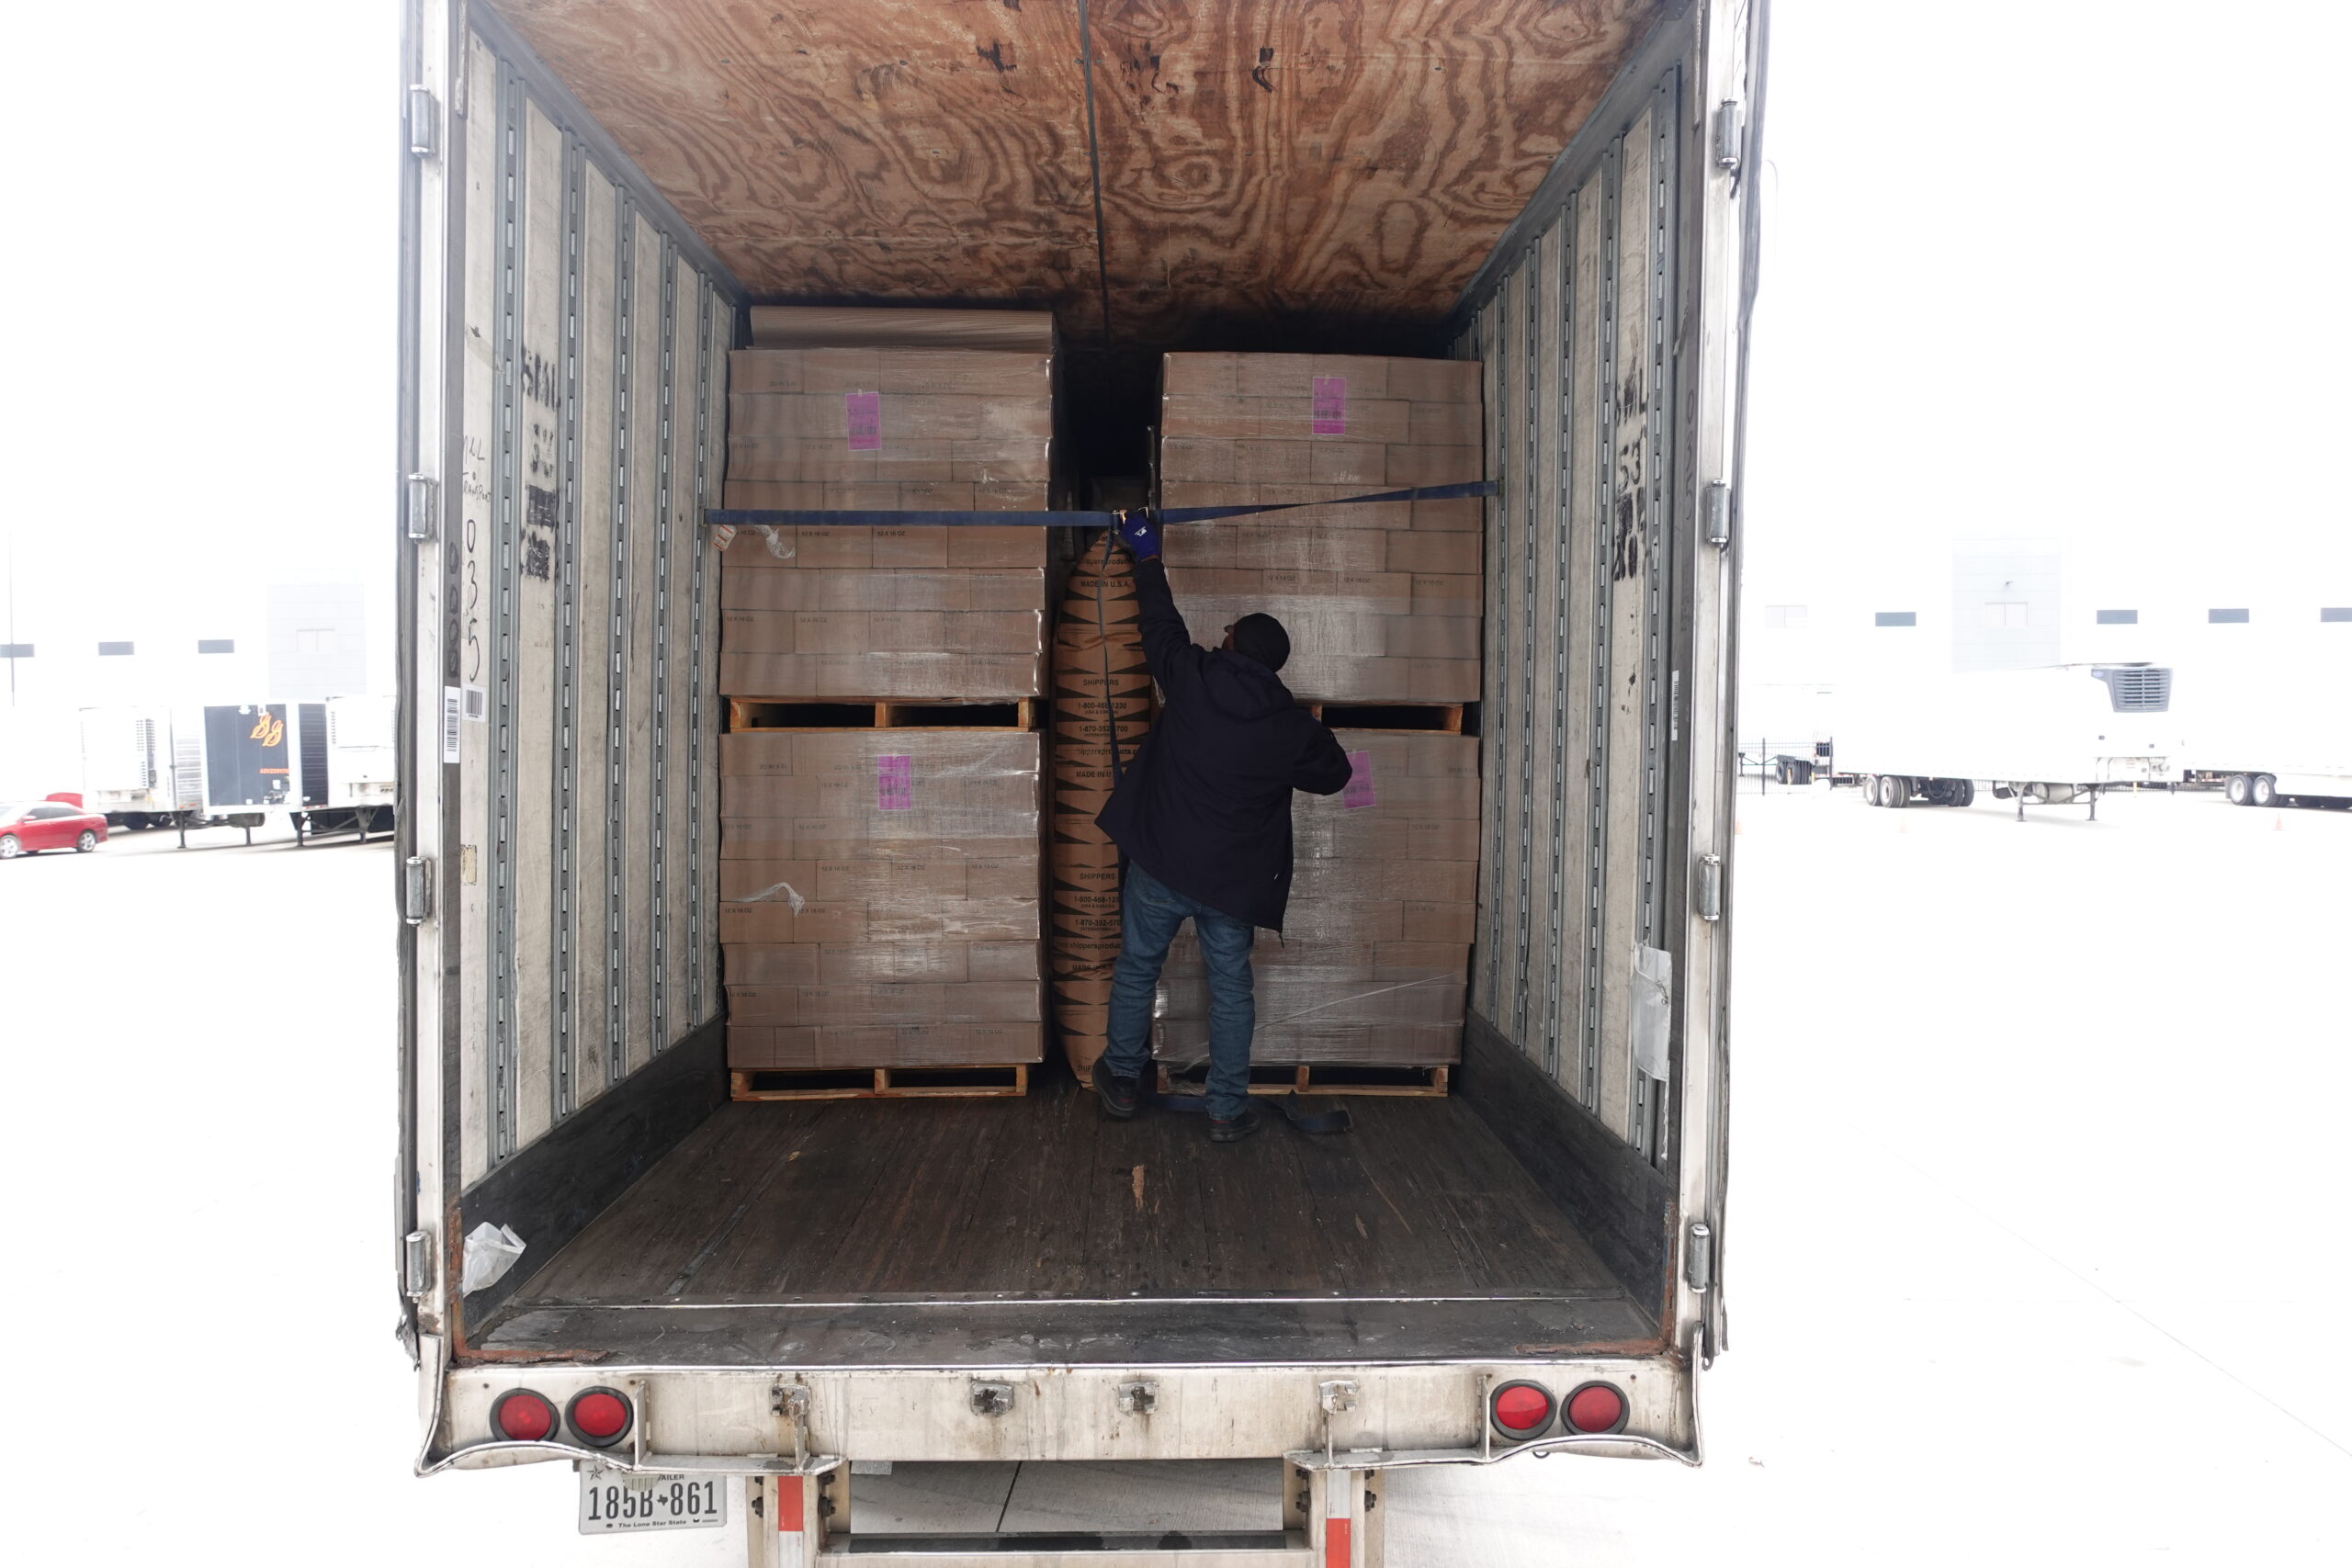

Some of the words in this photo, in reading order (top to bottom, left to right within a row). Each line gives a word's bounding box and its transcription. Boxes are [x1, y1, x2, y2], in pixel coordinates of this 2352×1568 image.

[463, 471, 492, 502] RANSPORT
[467, 519, 481, 682] 035
[588, 1486, 654, 1521] 185B
[670, 1480, 718, 1516] 861
